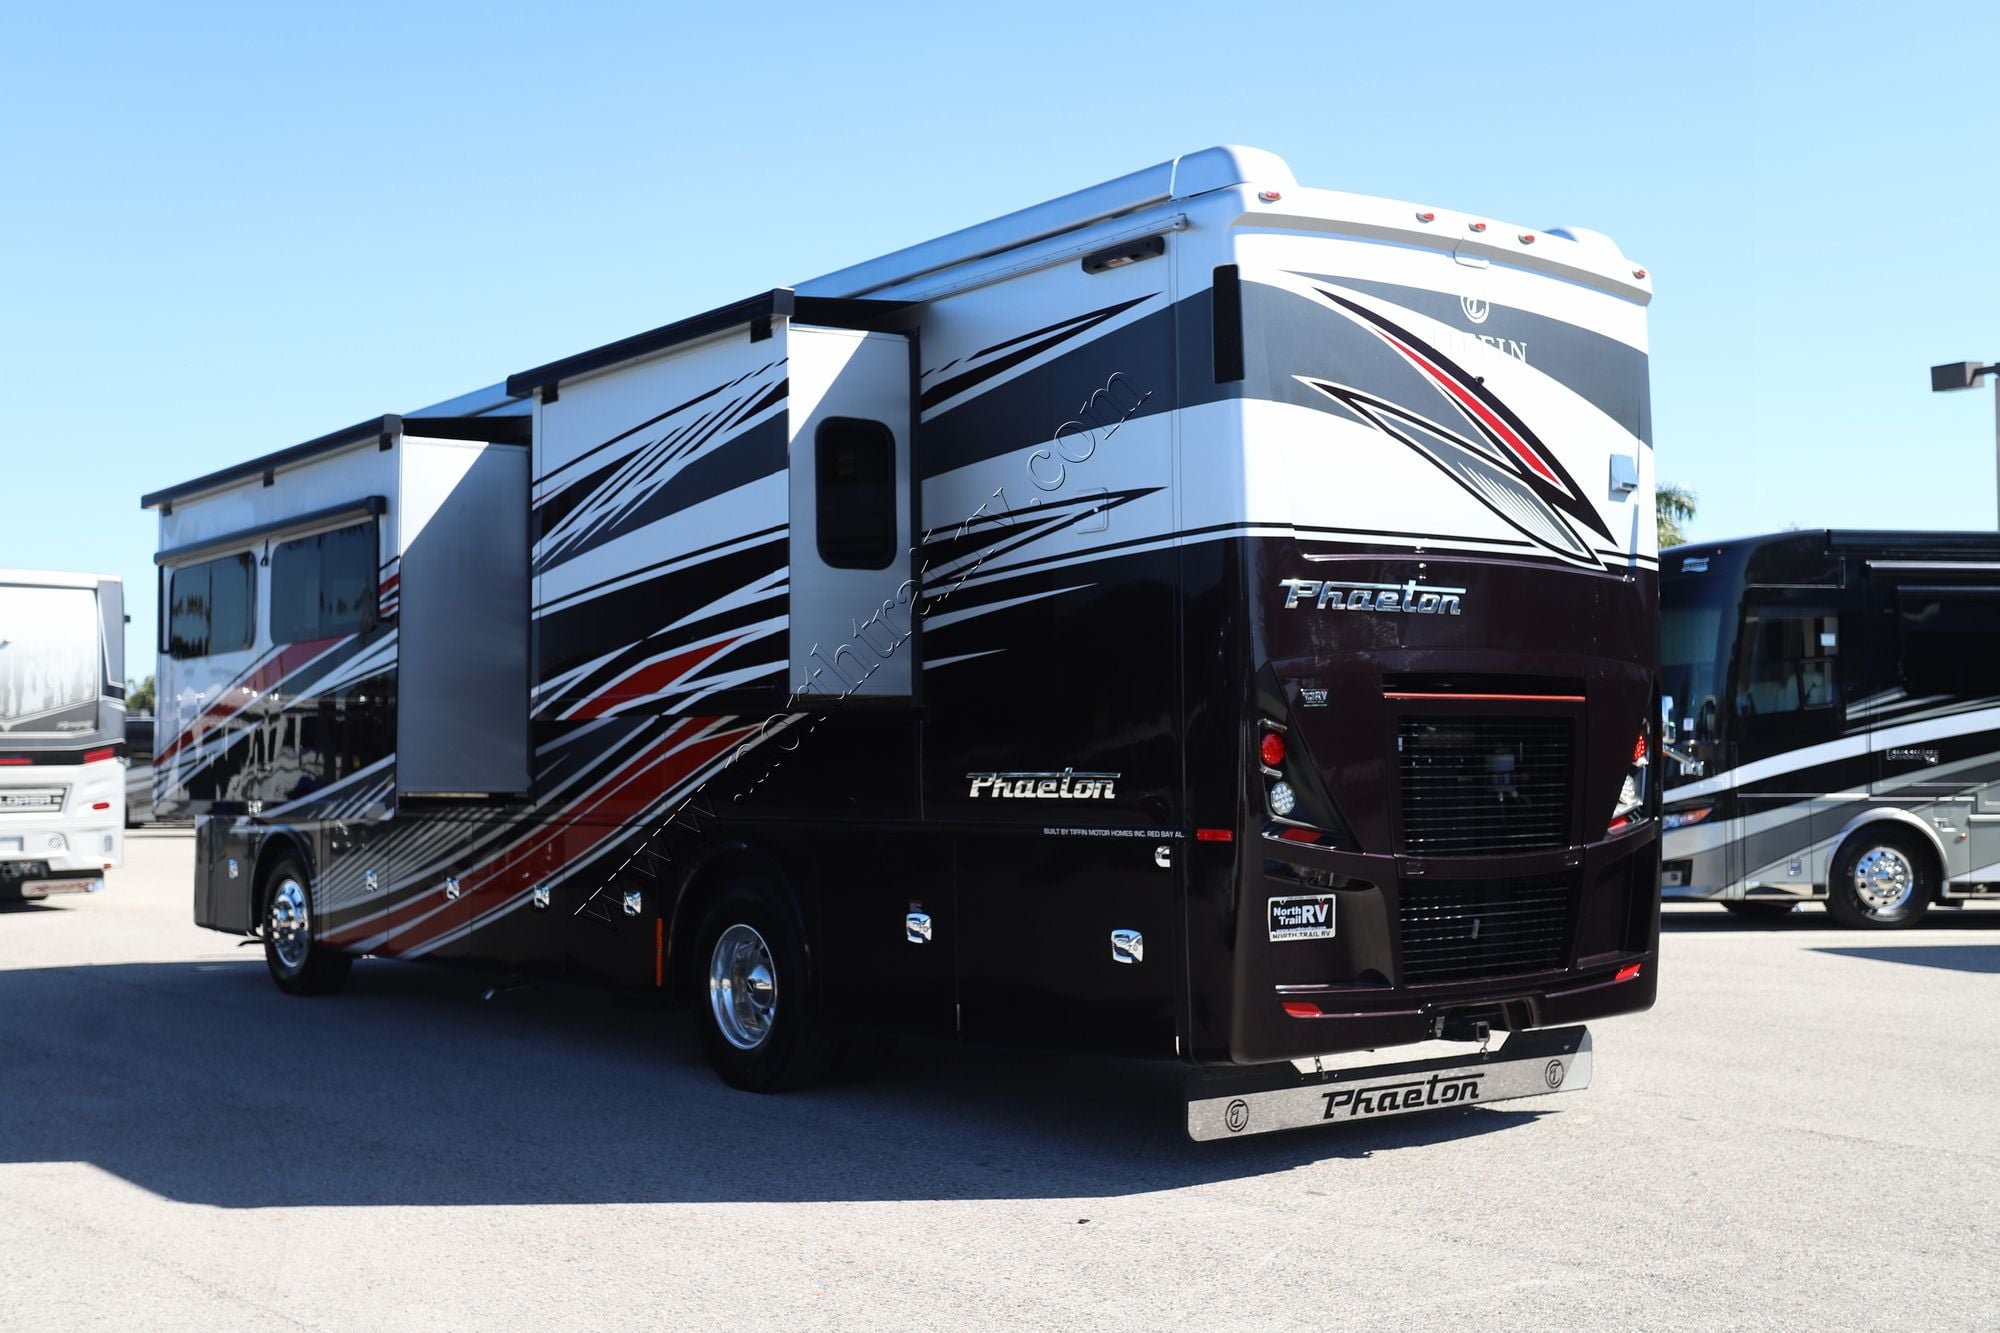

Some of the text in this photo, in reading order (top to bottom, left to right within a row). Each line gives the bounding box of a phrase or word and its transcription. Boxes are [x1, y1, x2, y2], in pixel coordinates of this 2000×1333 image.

[1279, 579, 1467, 615] Phaeton
[966, 767, 1121, 799] Phaeton
[1043, 827, 1060, 835] BUILT
[1069, 828, 1088, 836] TIFFIN
[1088, 829, 1111, 837] MOTOR
[1111, 829, 1133, 837] HOMES
[1147, 830, 1160, 838] RED
[1273, 905, 1302, 917] North
[1279, 915, 1302, 926] Trail
[1301, 904, 1329, 924] RV
[1321, 1074, 1485, 1119] Phaeton
